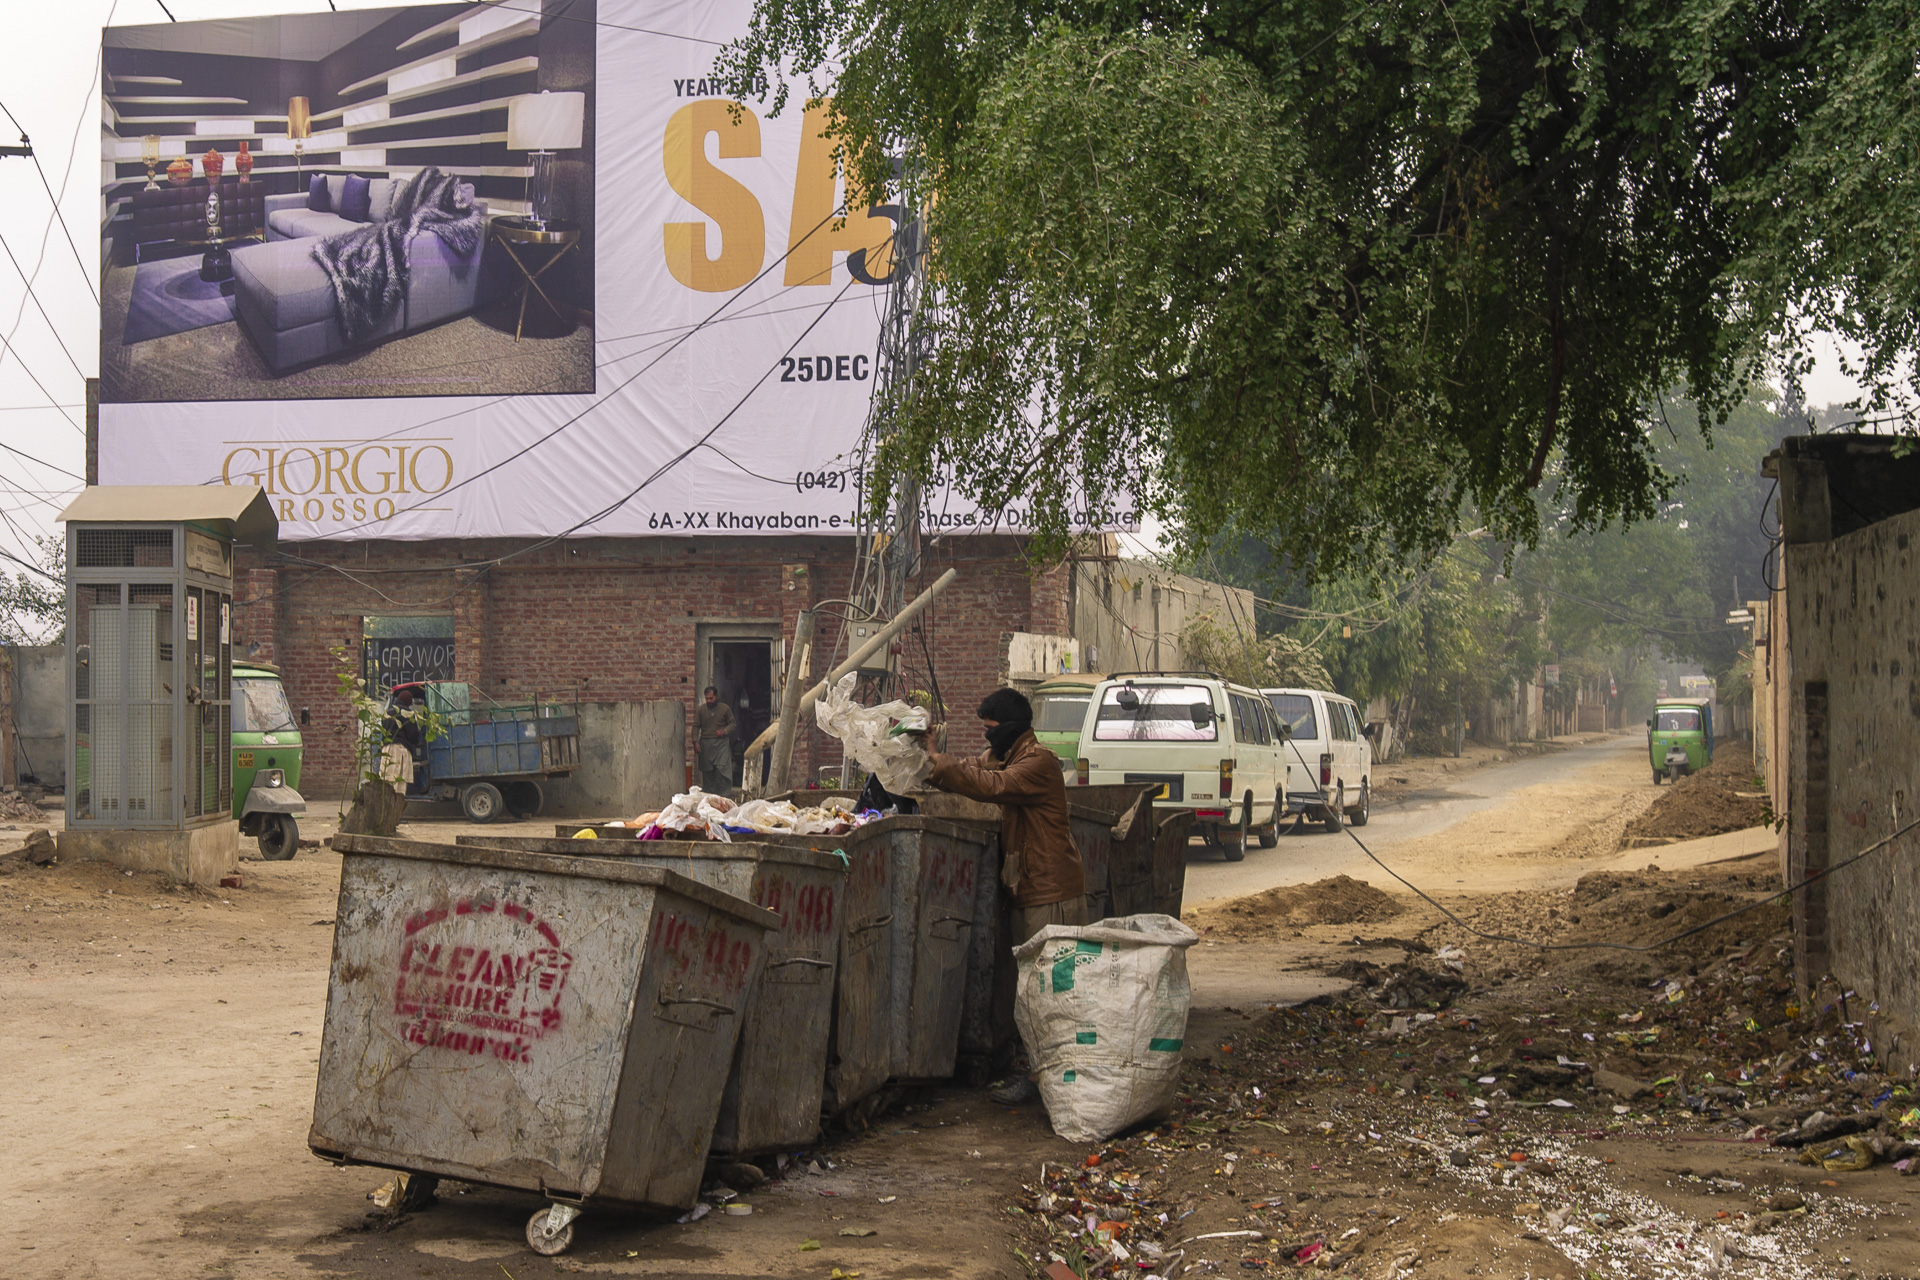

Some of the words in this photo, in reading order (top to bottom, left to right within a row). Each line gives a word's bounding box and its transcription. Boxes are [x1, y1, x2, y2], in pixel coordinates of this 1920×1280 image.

[673, 77, 722, 97] YEAR
[780, 354, 869, 383] 25DEC
[222, 444, 454, 495] GIORGIO
[796, 471, 846, 494] (042)
[278, 497, 396, 522] ROSSO
[648, 511, 710, 530] 6A-XX
[381, 644, 415, 669] CAR
[416, 644, 456, 668] WOR
[381, 669, 434, 688] CHECK
